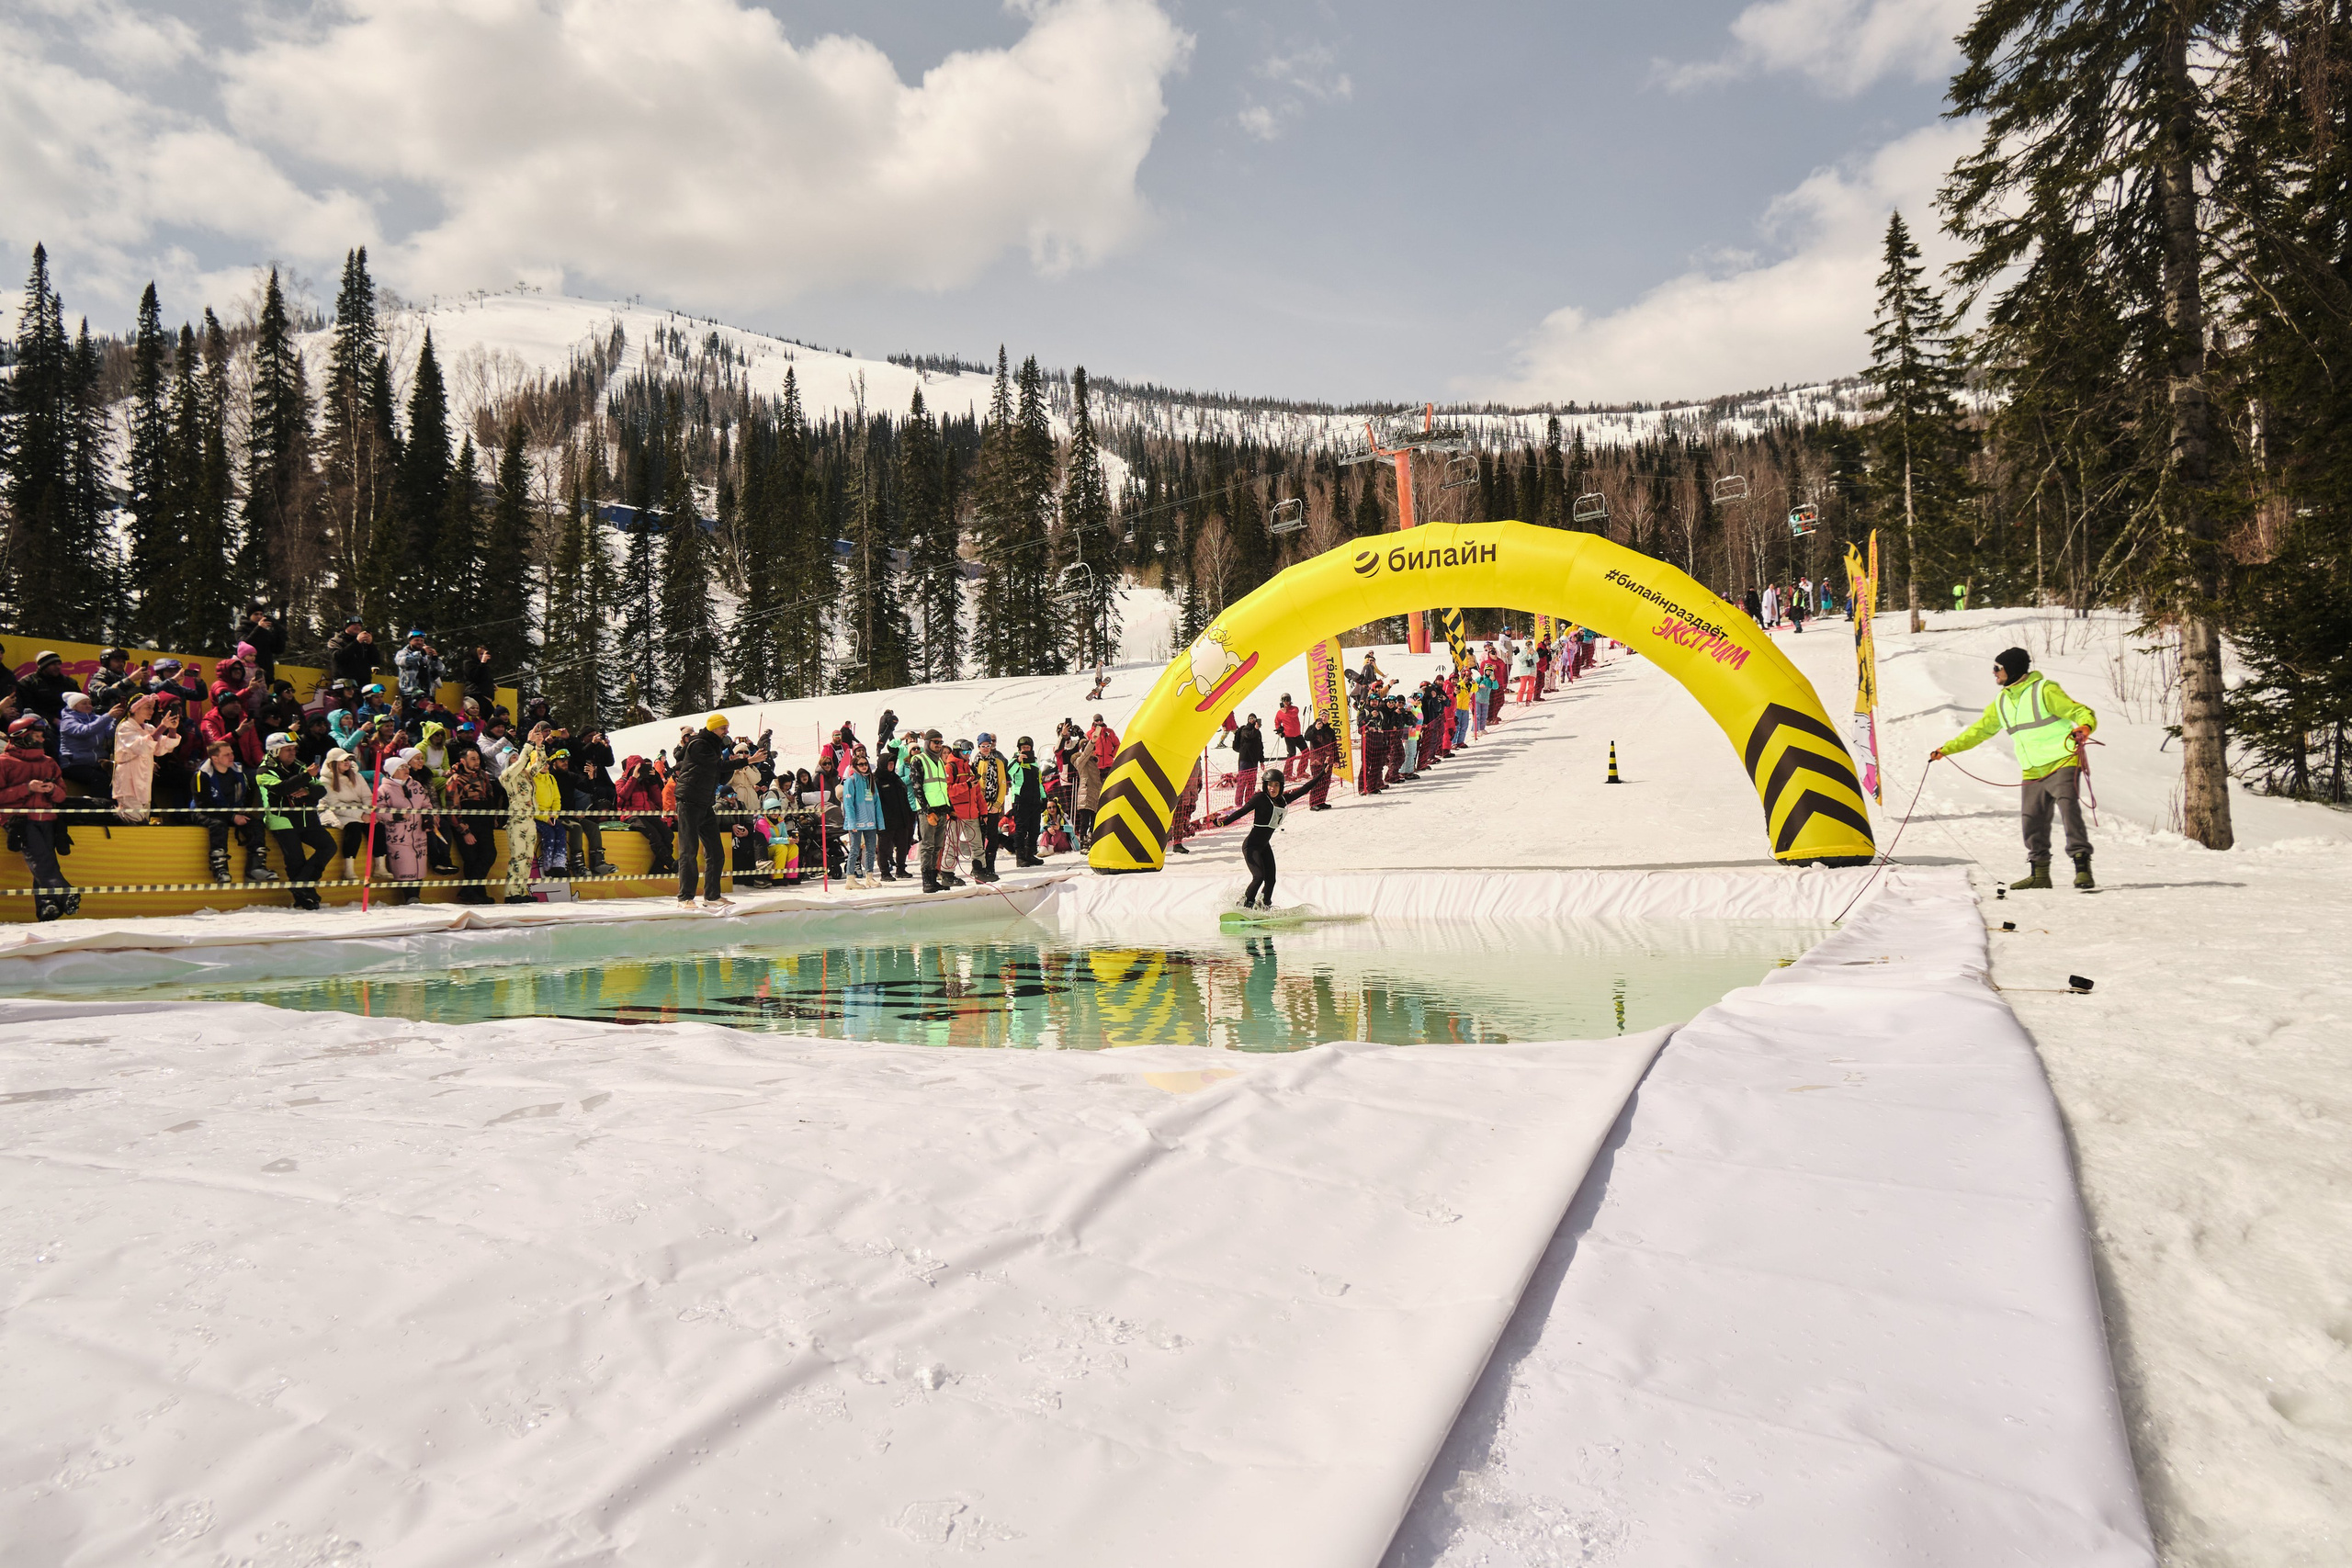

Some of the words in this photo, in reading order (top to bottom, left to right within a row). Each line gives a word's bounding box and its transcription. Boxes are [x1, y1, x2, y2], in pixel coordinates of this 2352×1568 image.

[1388, 540, 1497, 572] билайн
[1604, 569, 1728, 641] #билайнраздаёт
[1652, 616, 1751, 671] ЭКСТРИМ
